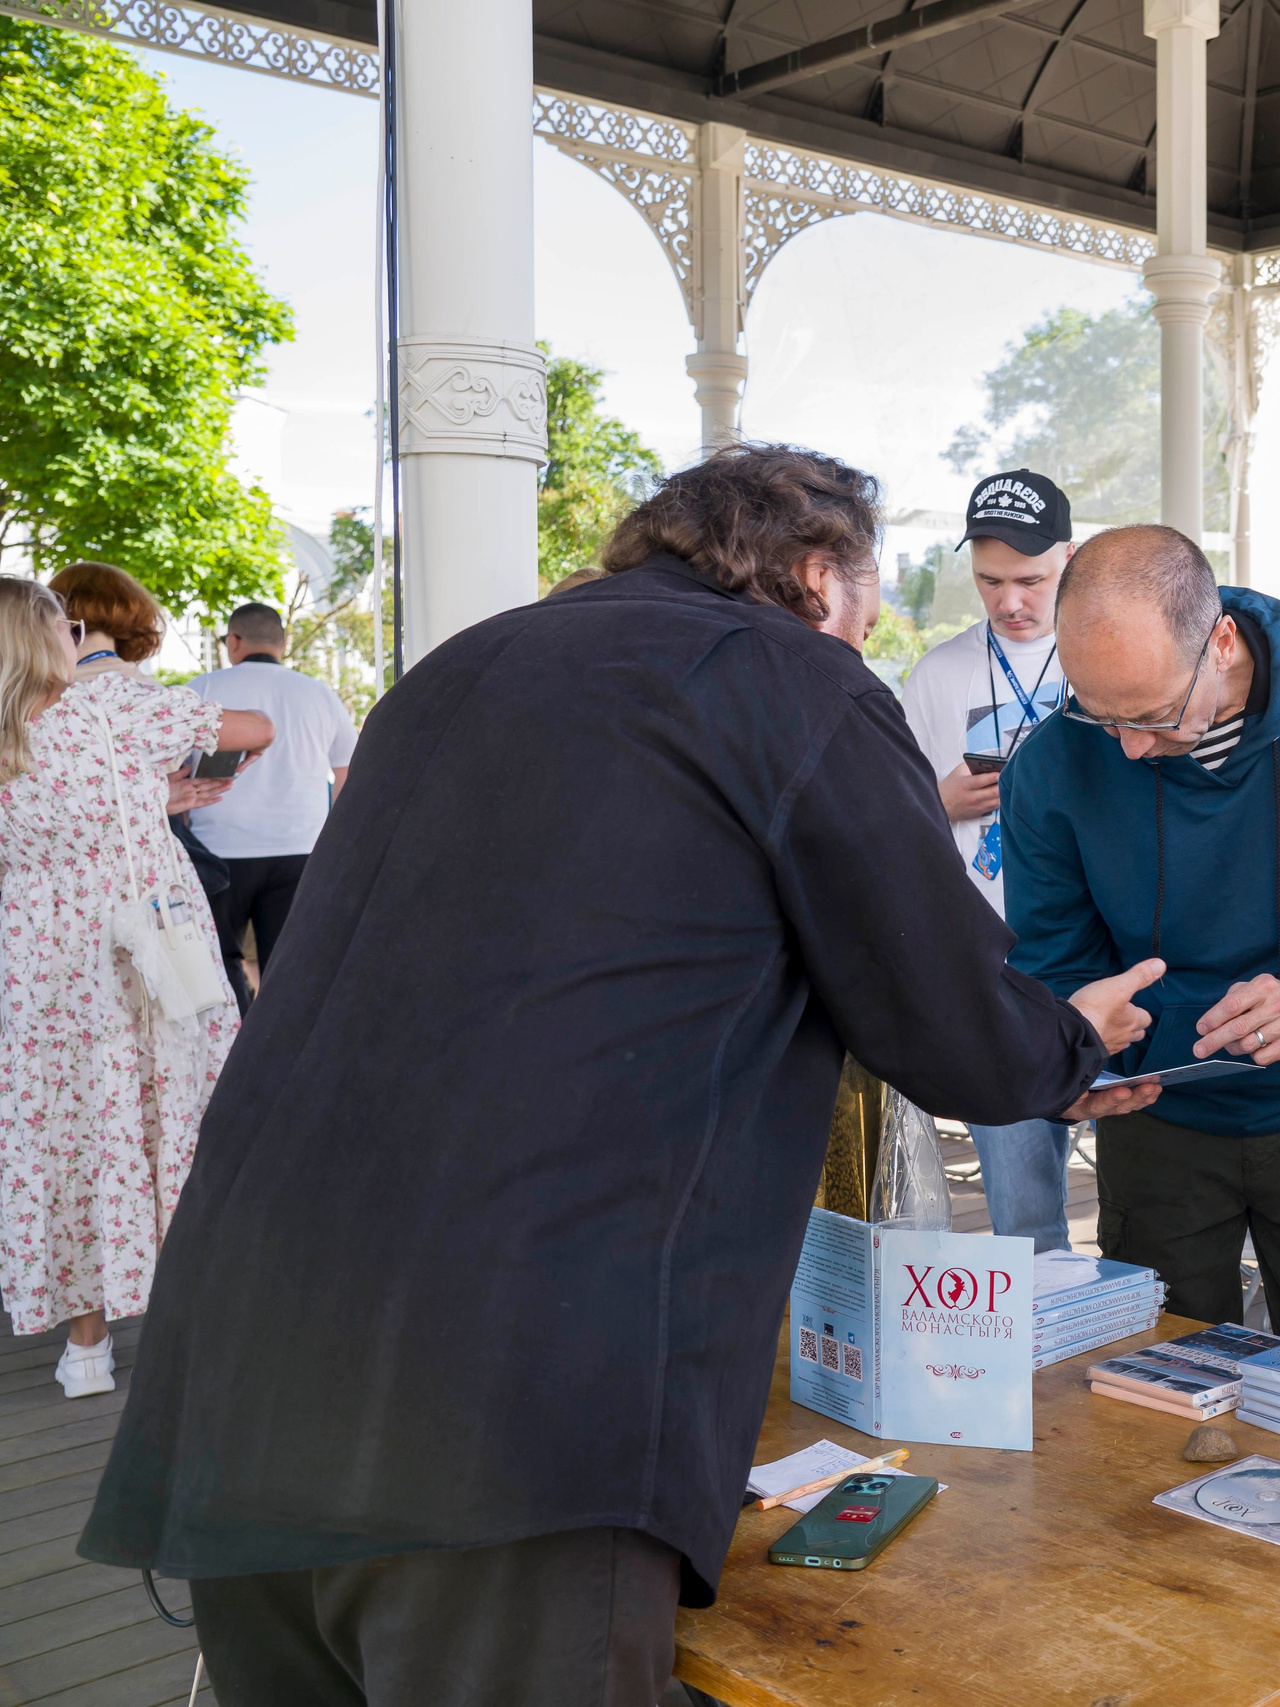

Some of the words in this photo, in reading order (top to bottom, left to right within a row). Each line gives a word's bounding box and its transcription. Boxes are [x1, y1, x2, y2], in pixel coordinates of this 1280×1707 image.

[974, 479, 1046, 513] DSQUARED2
[901, 1264, 1012, 1313] ХОР
[901, 1321, 1013, 1339] МОНАСТЫРЯ
[902, 1309, 1014, 1328] ВАЛААМСКОГО
